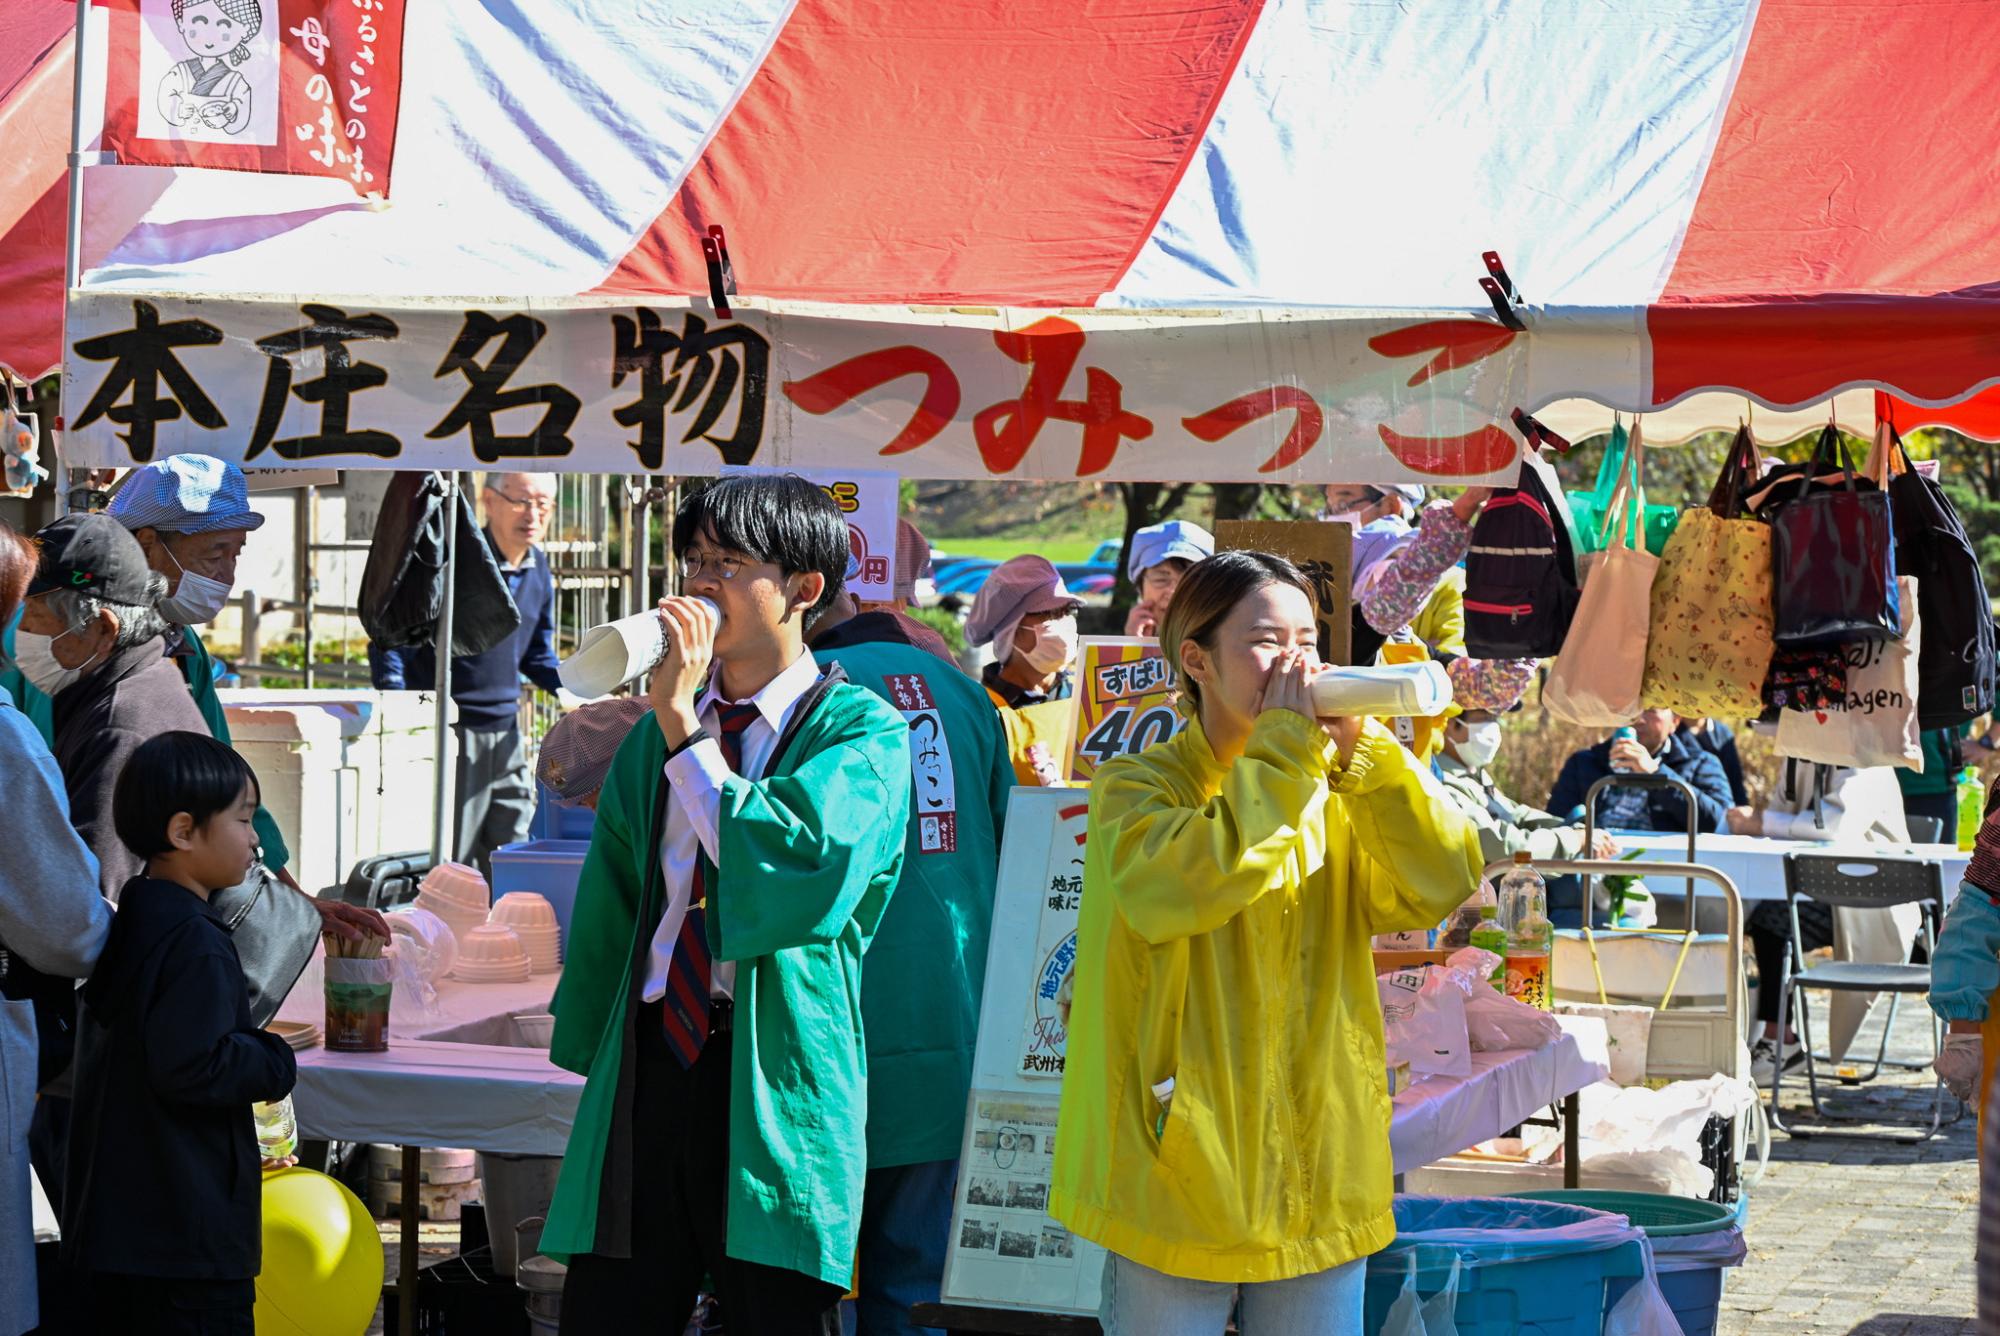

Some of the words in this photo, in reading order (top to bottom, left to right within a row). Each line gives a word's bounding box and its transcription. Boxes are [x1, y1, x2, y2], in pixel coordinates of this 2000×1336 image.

[72, 300, 770, 469] 本庄名物
[783, 316, 1519, 477] つみっこ
[1084, 710, 1189, 762] 40
[1040, 935, 1077, 1000] 地元野
